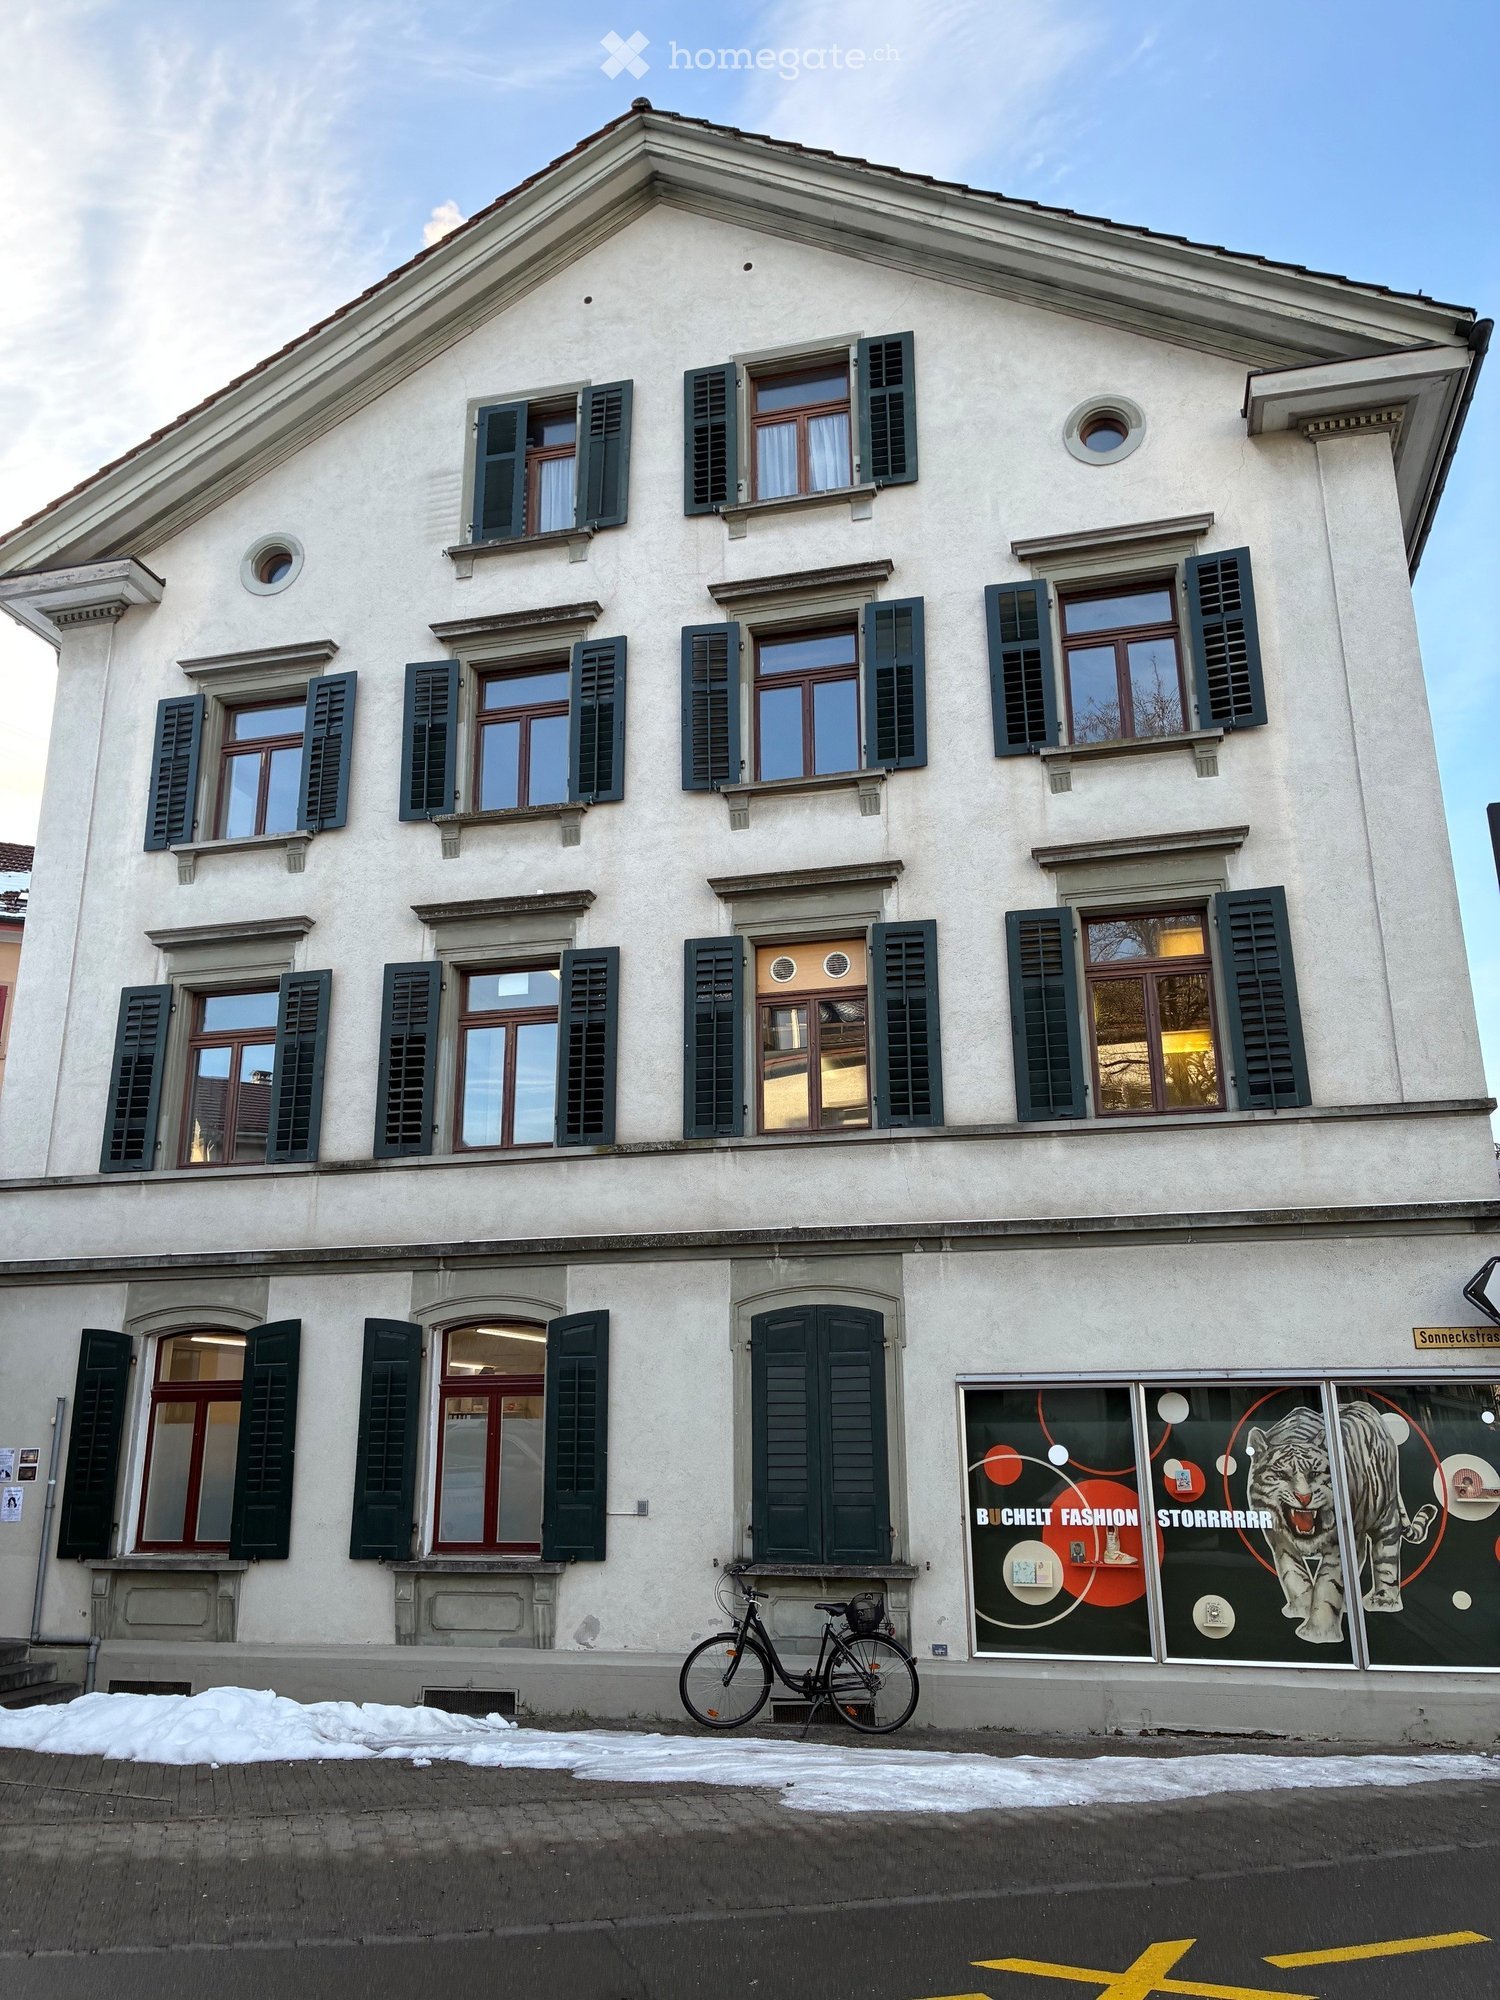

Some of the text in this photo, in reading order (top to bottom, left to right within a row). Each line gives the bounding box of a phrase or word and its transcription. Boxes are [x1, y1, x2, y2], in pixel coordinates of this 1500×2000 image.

[976, 1507, 1273, 1529] BUCHELT FASHION STORRRRRR
